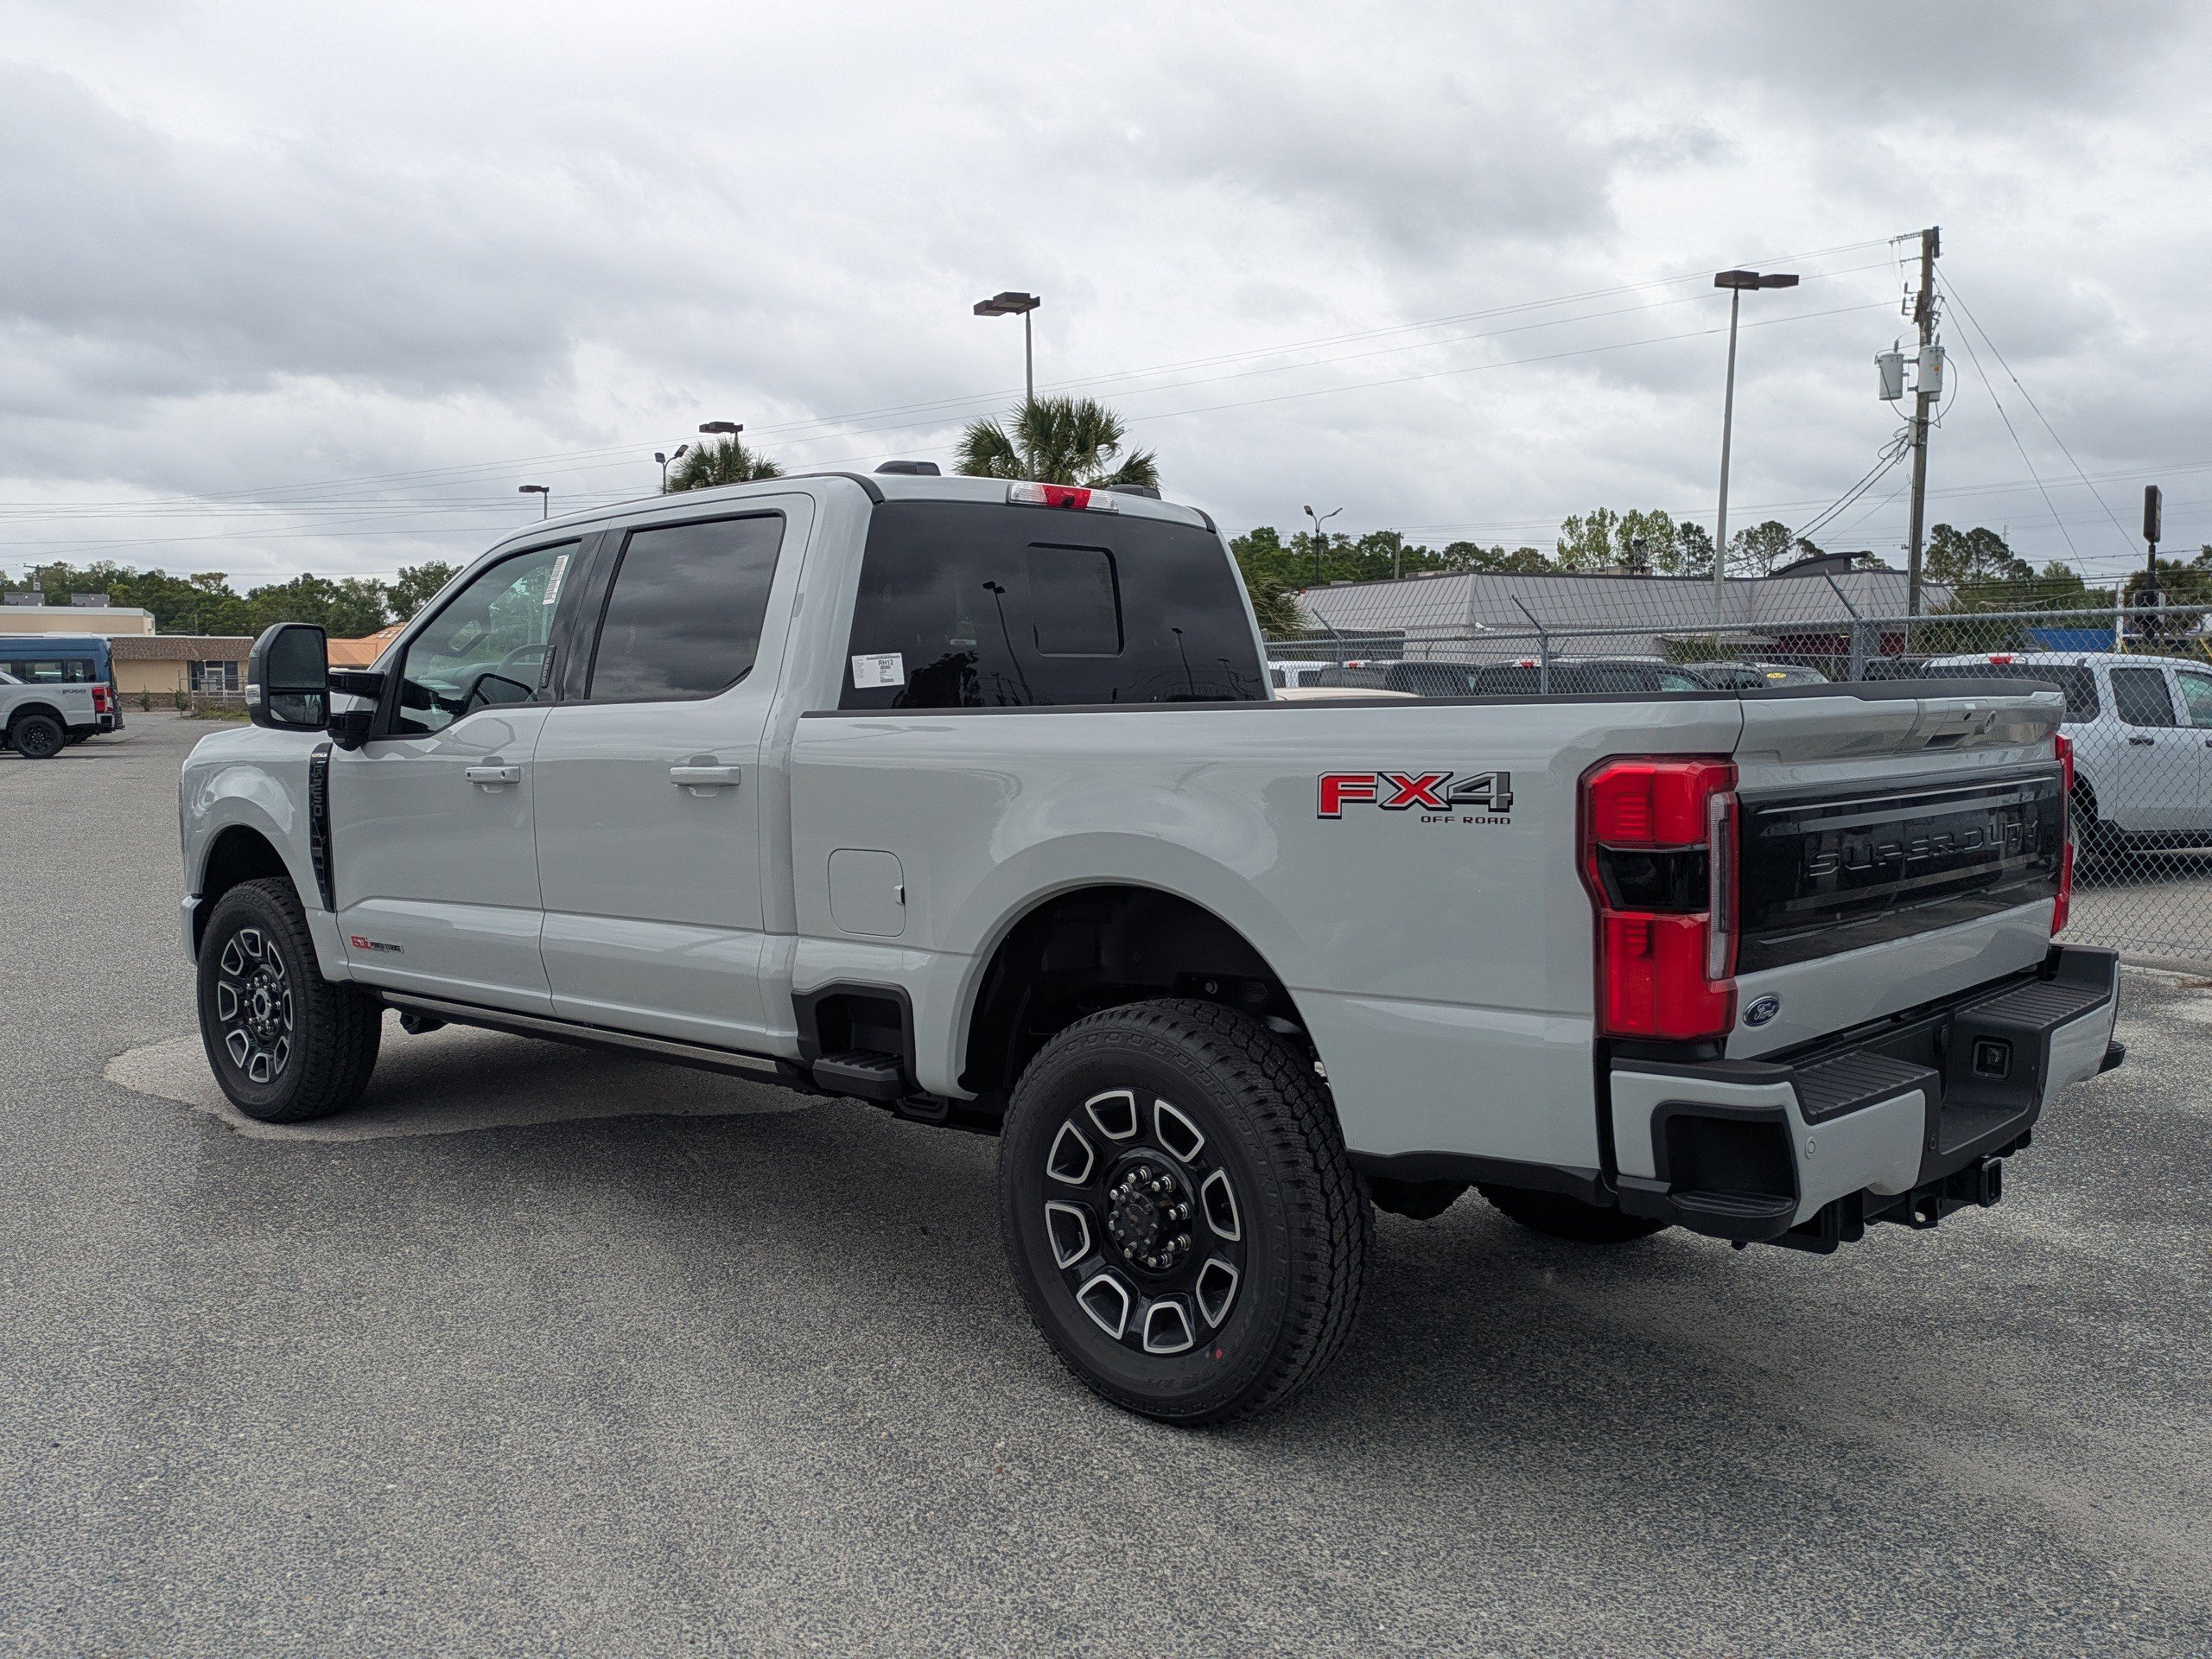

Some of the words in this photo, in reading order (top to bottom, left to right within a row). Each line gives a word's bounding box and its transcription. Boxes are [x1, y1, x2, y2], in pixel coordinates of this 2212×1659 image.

[1317, 771, 1514, 819] FX4
[1463, 817, 1511, 825] ROAD
[1808, 832, 1955, 877] SUPER
[1963, 817, 2040, 850] DUTY
[1754, 1002, 1776, 1020] Ford
